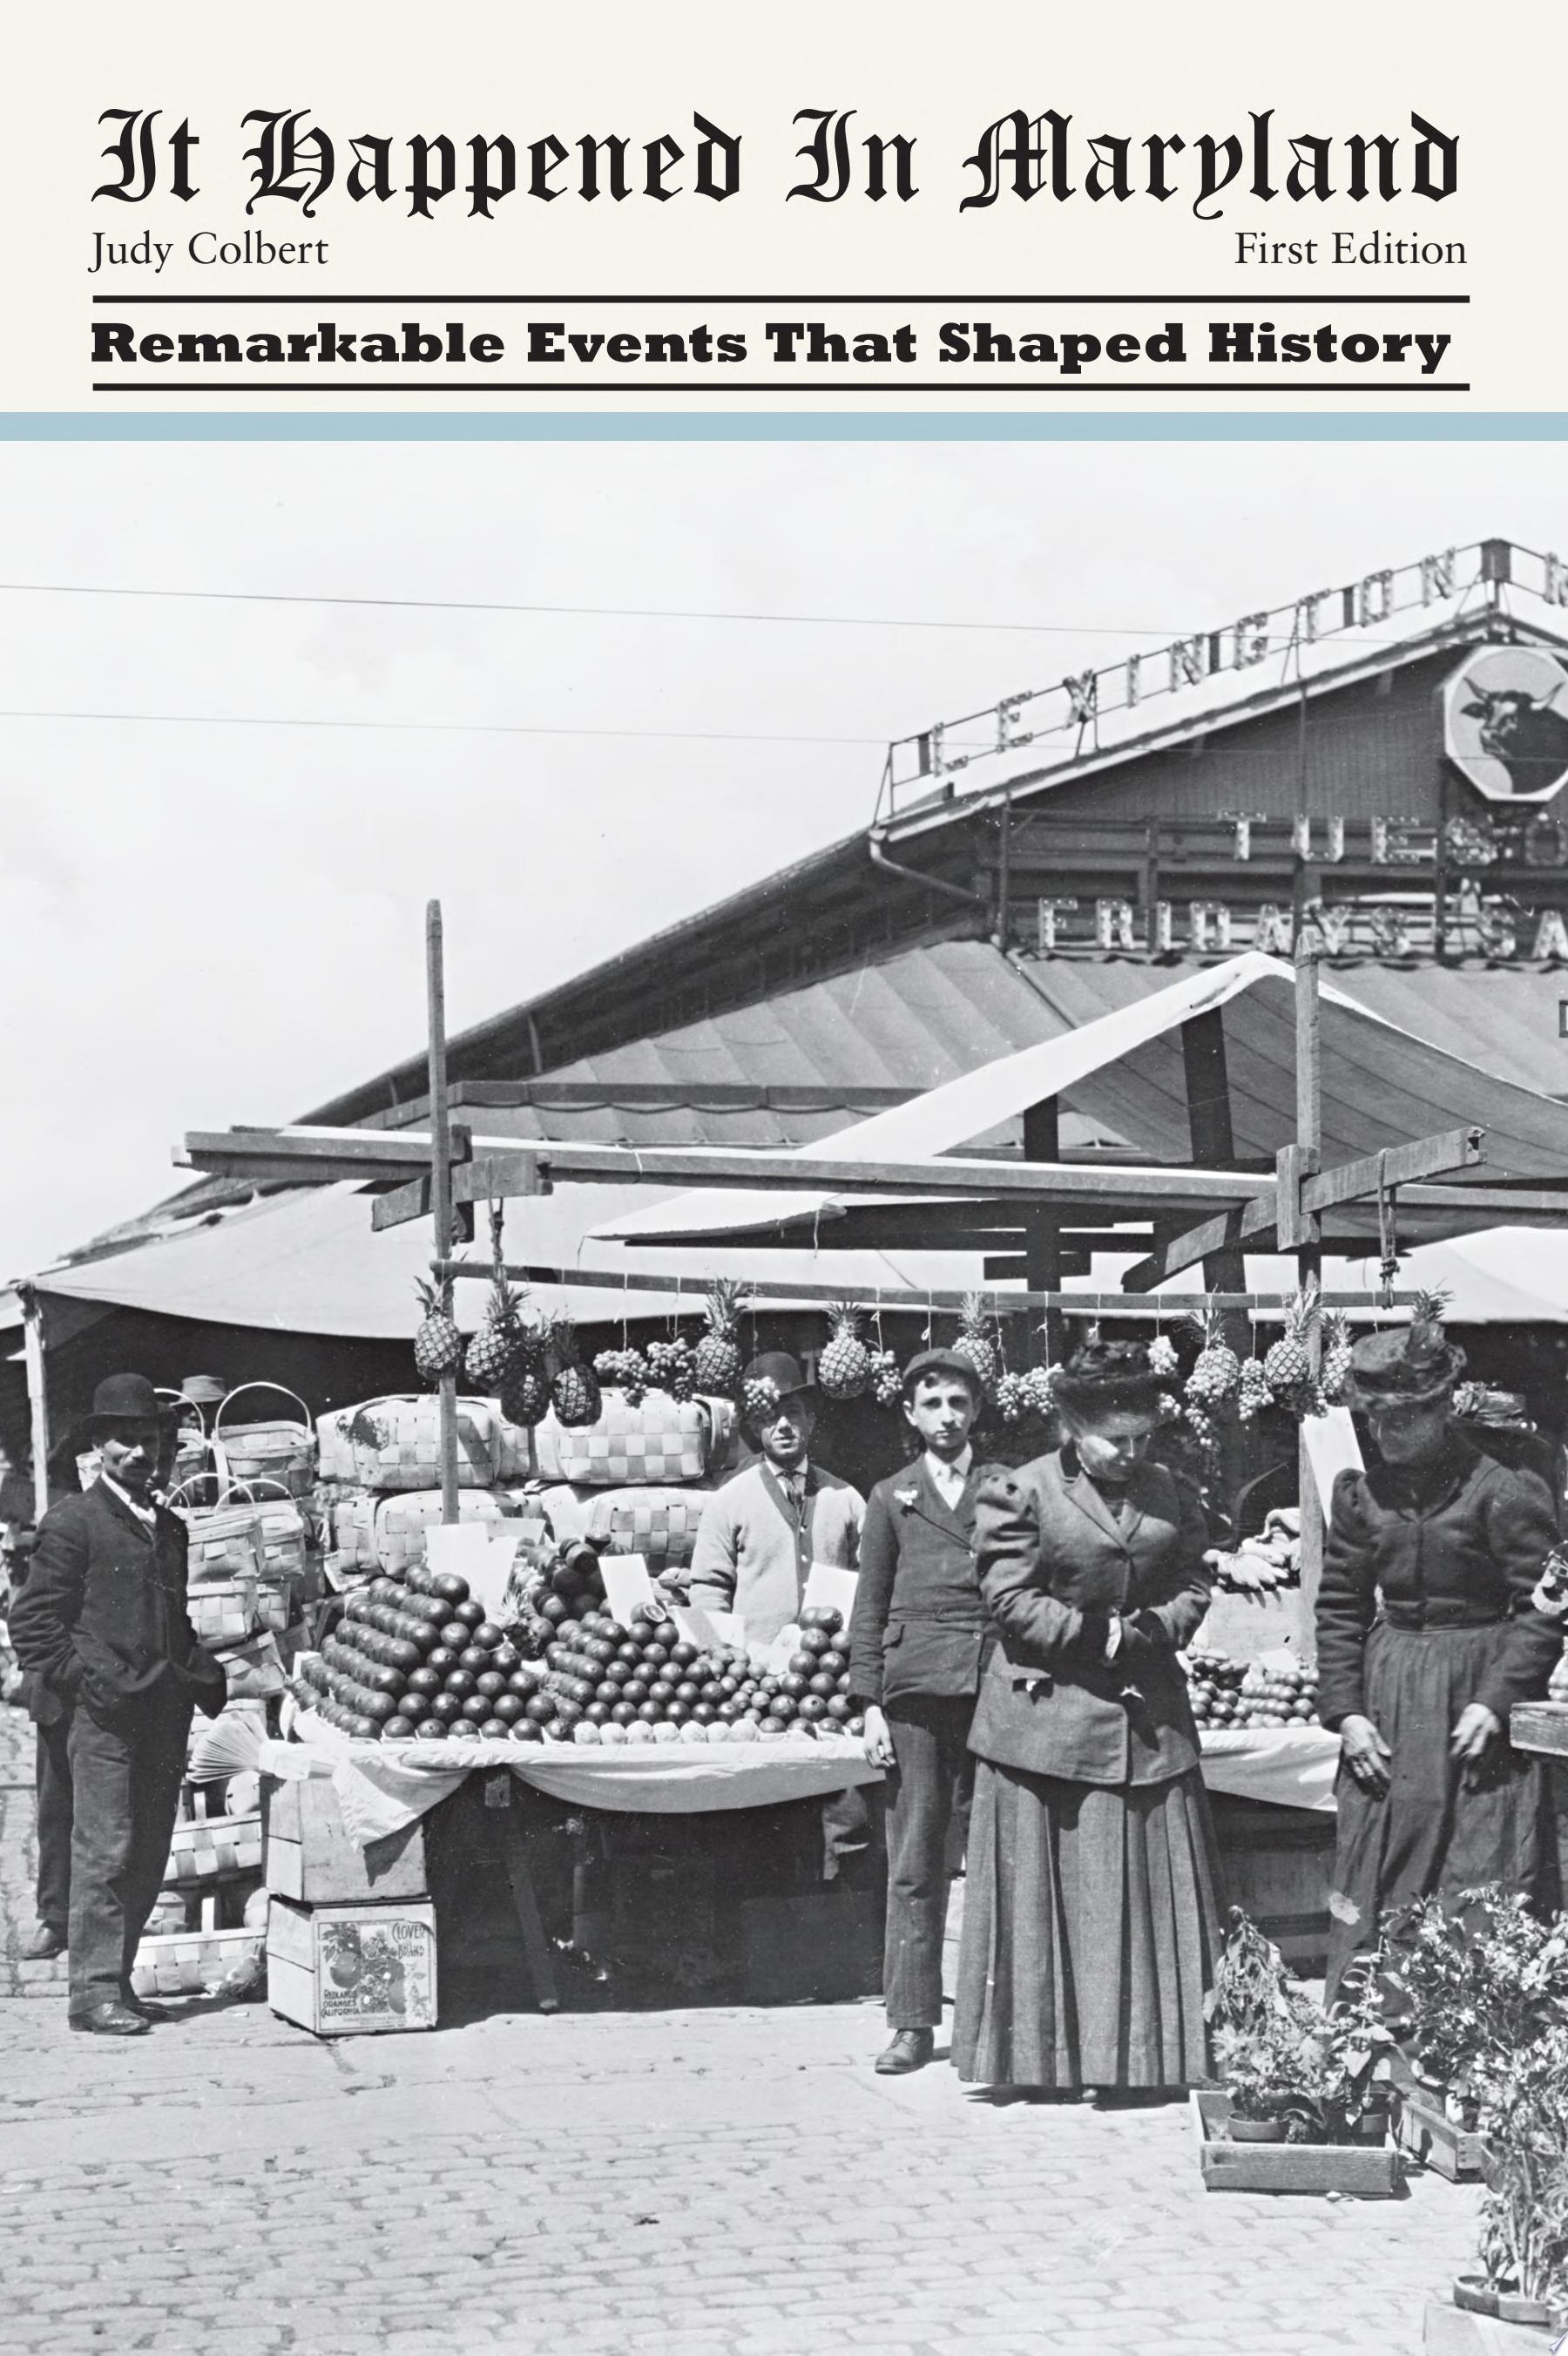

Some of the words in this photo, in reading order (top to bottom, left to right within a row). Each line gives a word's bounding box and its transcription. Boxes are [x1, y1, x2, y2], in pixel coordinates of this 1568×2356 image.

[929, 546, 1456, 778] LEXINGTON
[1038, 897, 1411, 957] FRIDAYS
[392, 1921, 426, 1943] CLOVER
[397, 1944, 425, 1960] BRAND
[321, 2007, 361, 2018] CALIFORNIA
